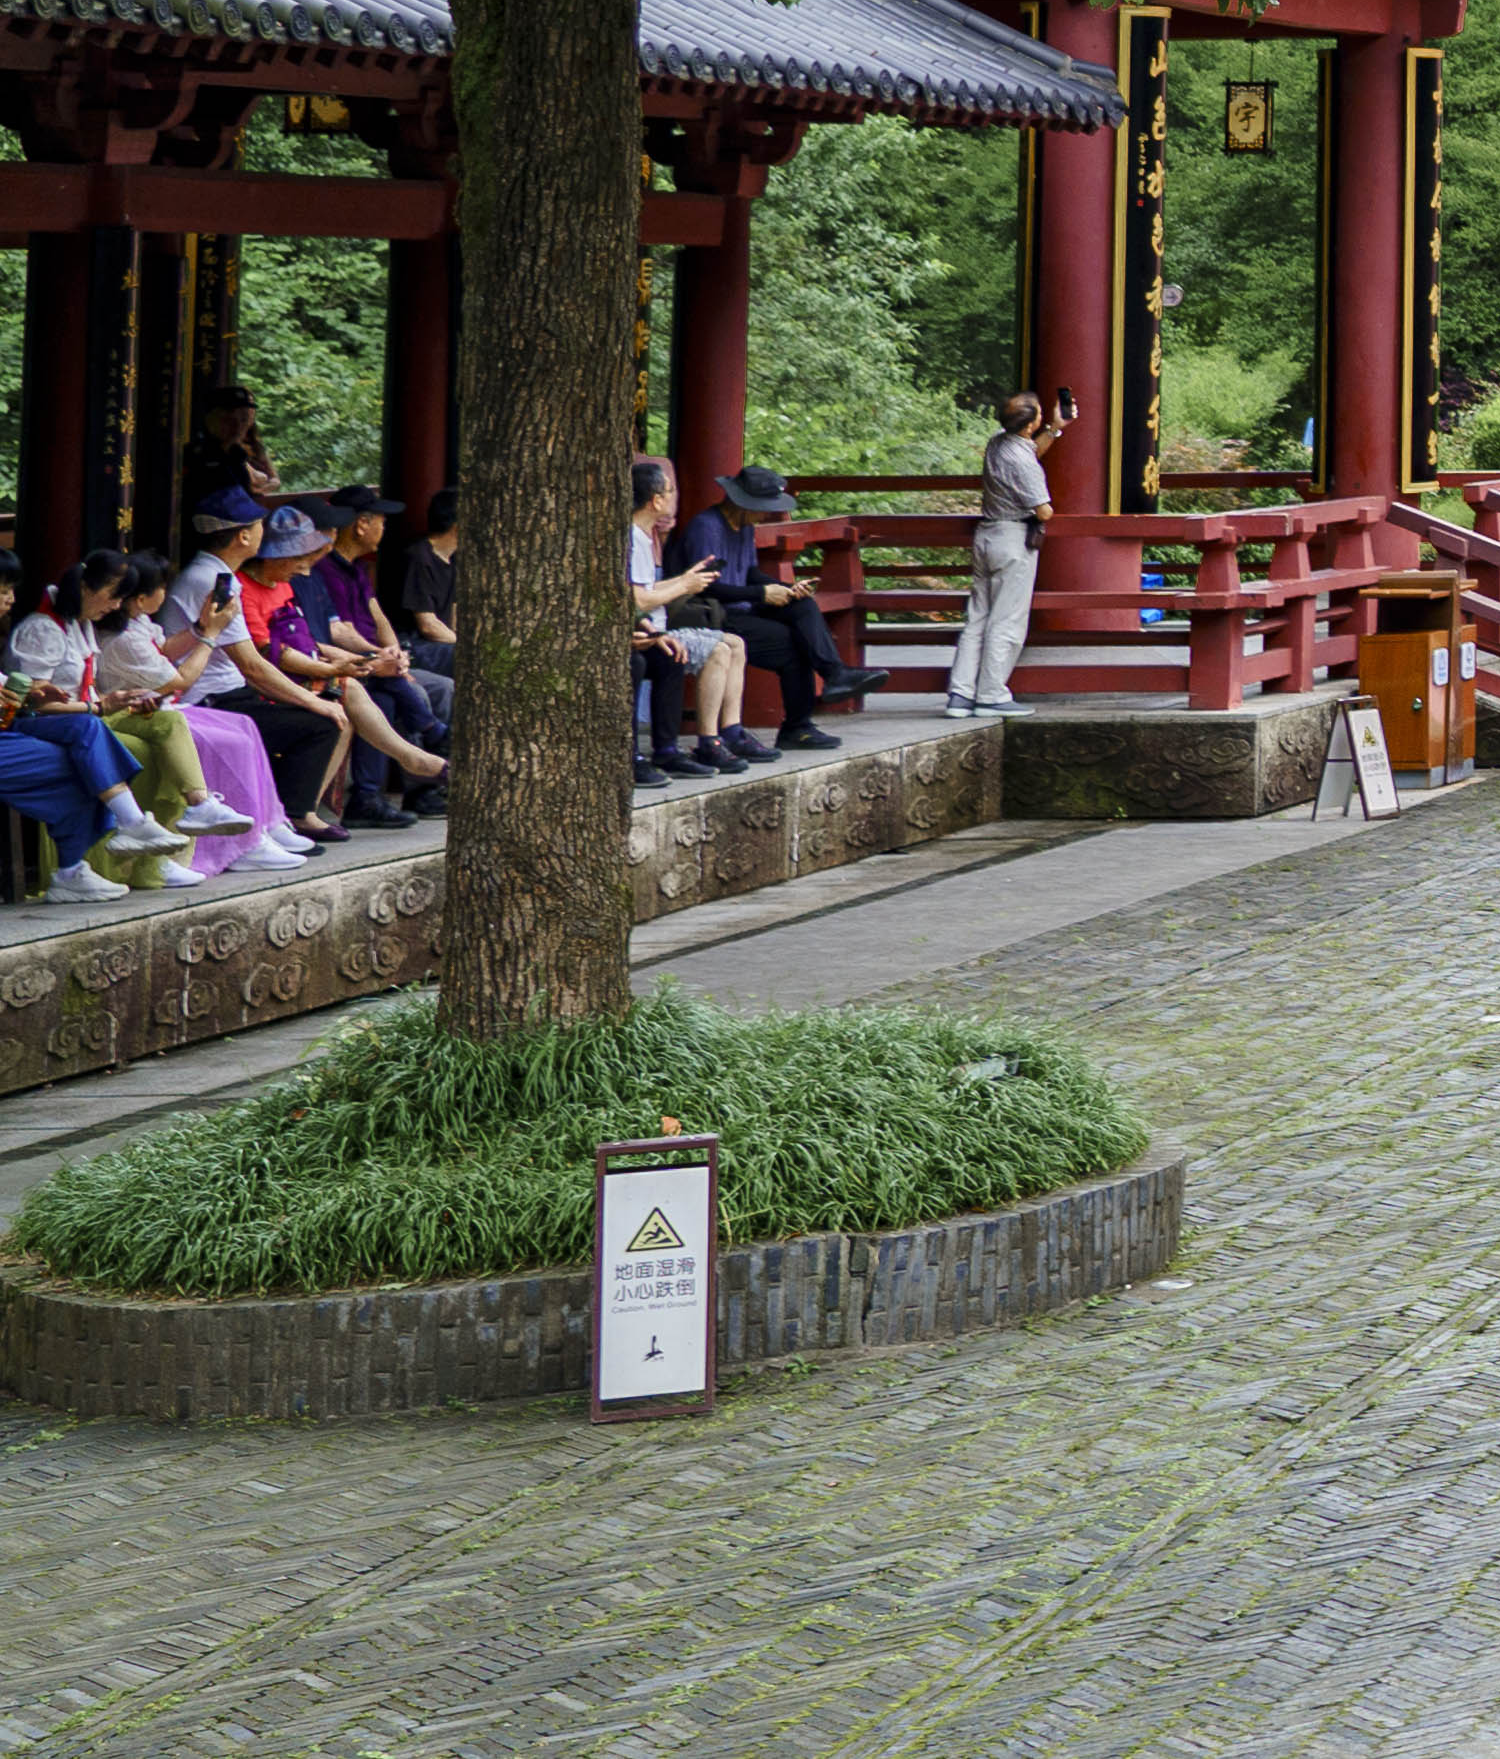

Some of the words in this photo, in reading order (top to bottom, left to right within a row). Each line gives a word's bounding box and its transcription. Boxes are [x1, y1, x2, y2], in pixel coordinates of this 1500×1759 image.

[1234, 102, 1259, 133] 宇
[614, 1257, 696, 1281] 地面湿滑
[613, 1279, 695, 1302] 小心跌倒
